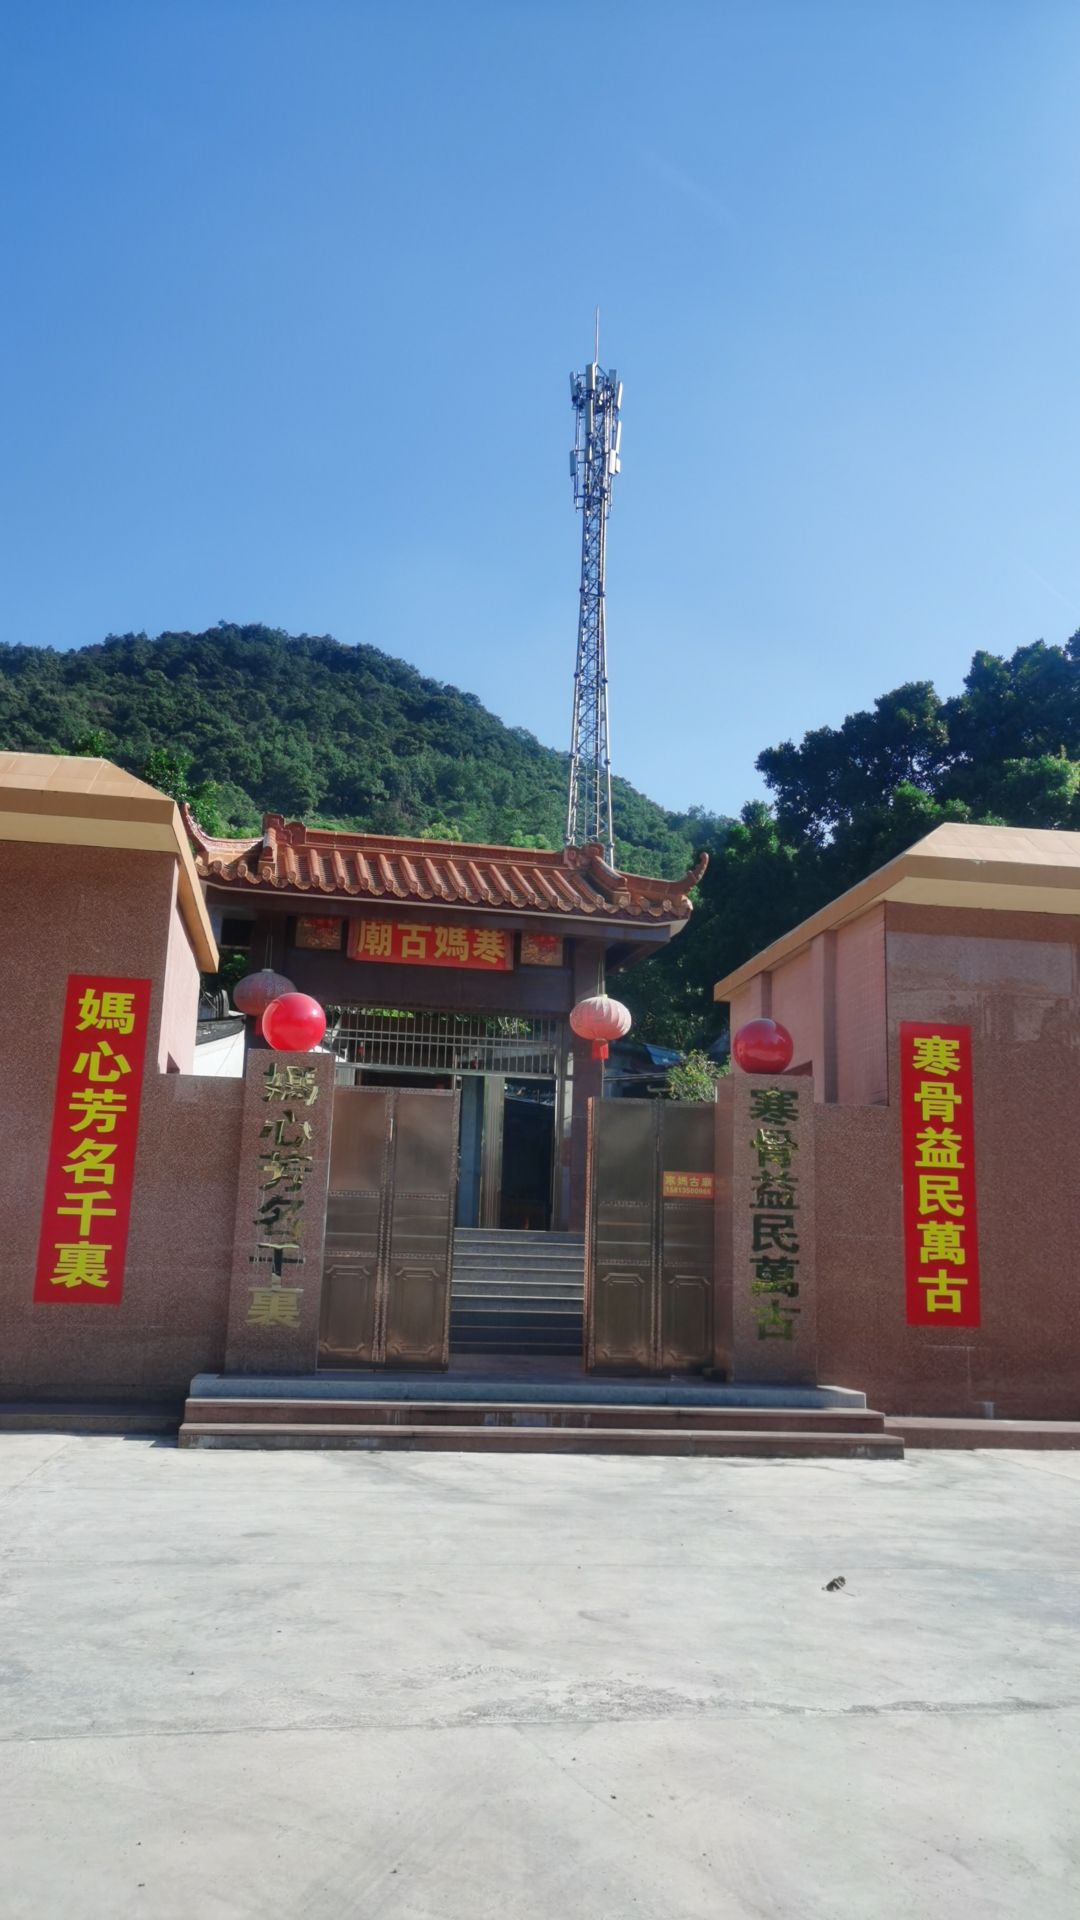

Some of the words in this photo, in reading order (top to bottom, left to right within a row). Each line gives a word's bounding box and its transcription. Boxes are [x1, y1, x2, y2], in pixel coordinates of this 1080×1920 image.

[49, 988, 136, 1288] 媽心芳名千裏
[912, 1035, 969, 1313] 寒骨益民萬古
